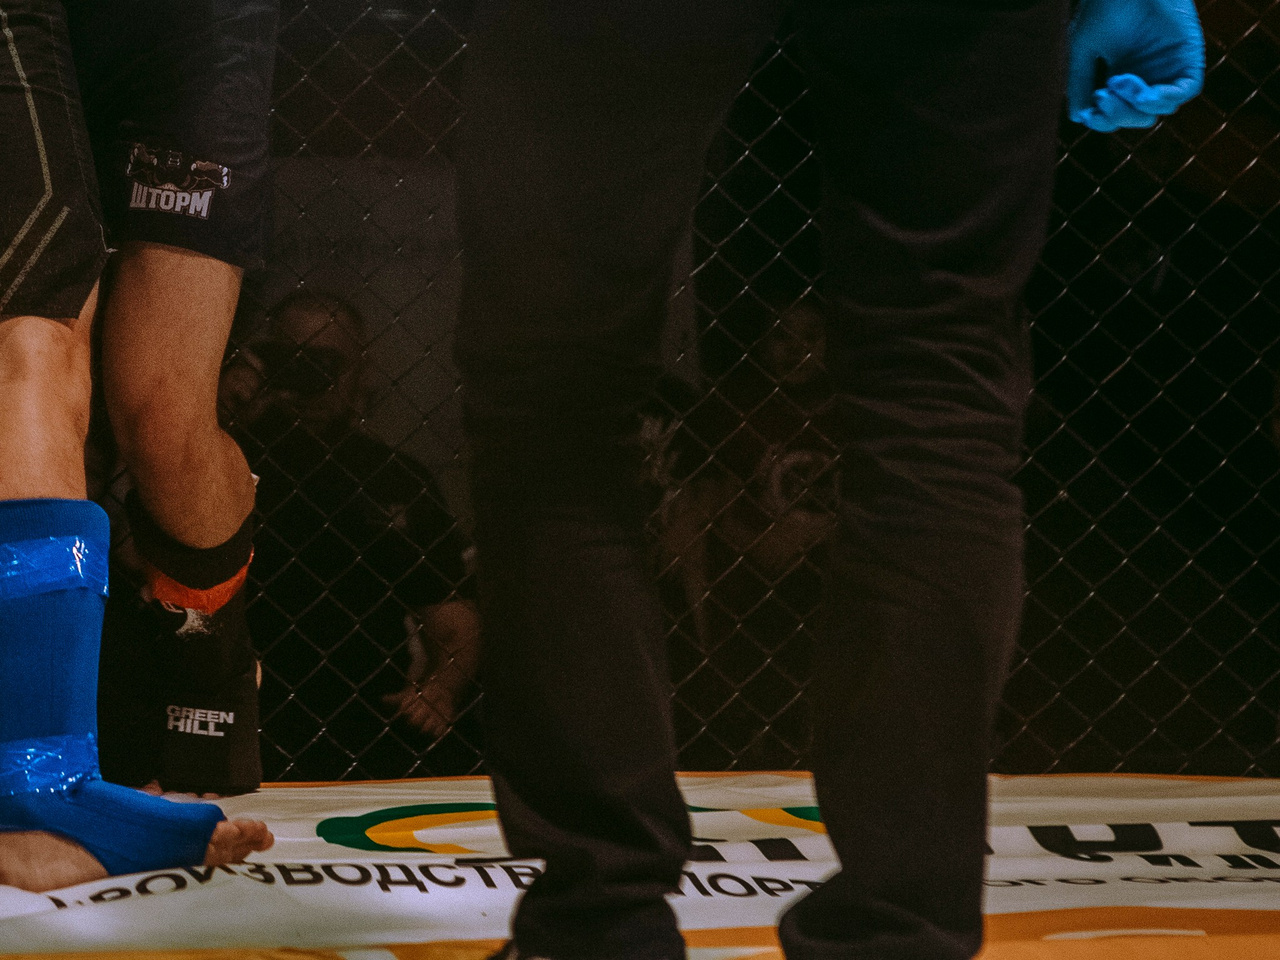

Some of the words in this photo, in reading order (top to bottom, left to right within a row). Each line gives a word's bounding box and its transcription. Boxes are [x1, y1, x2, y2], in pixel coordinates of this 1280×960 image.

[129, 181, 216, 220] ШТОРМ
[166, 705, 235, 724] GREEN
[167, 715, 225, 737] HILL
